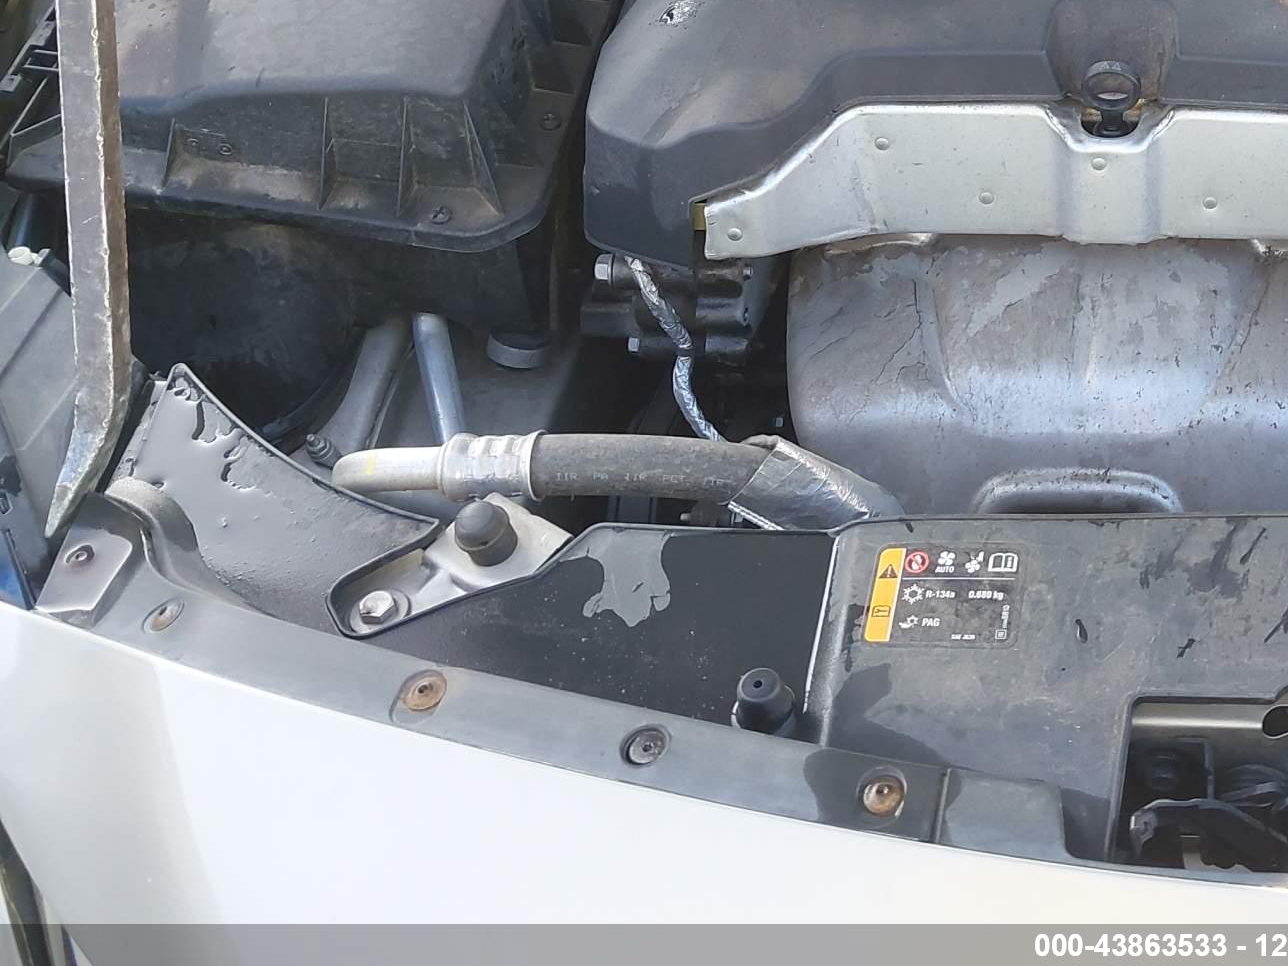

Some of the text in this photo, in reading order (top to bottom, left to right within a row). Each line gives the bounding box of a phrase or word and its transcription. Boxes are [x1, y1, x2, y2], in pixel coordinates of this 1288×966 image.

[925, 590, 956, 598] R-134a
[993, 590, 1004, 600] kg
[921, 617, 941, 627] PAG
